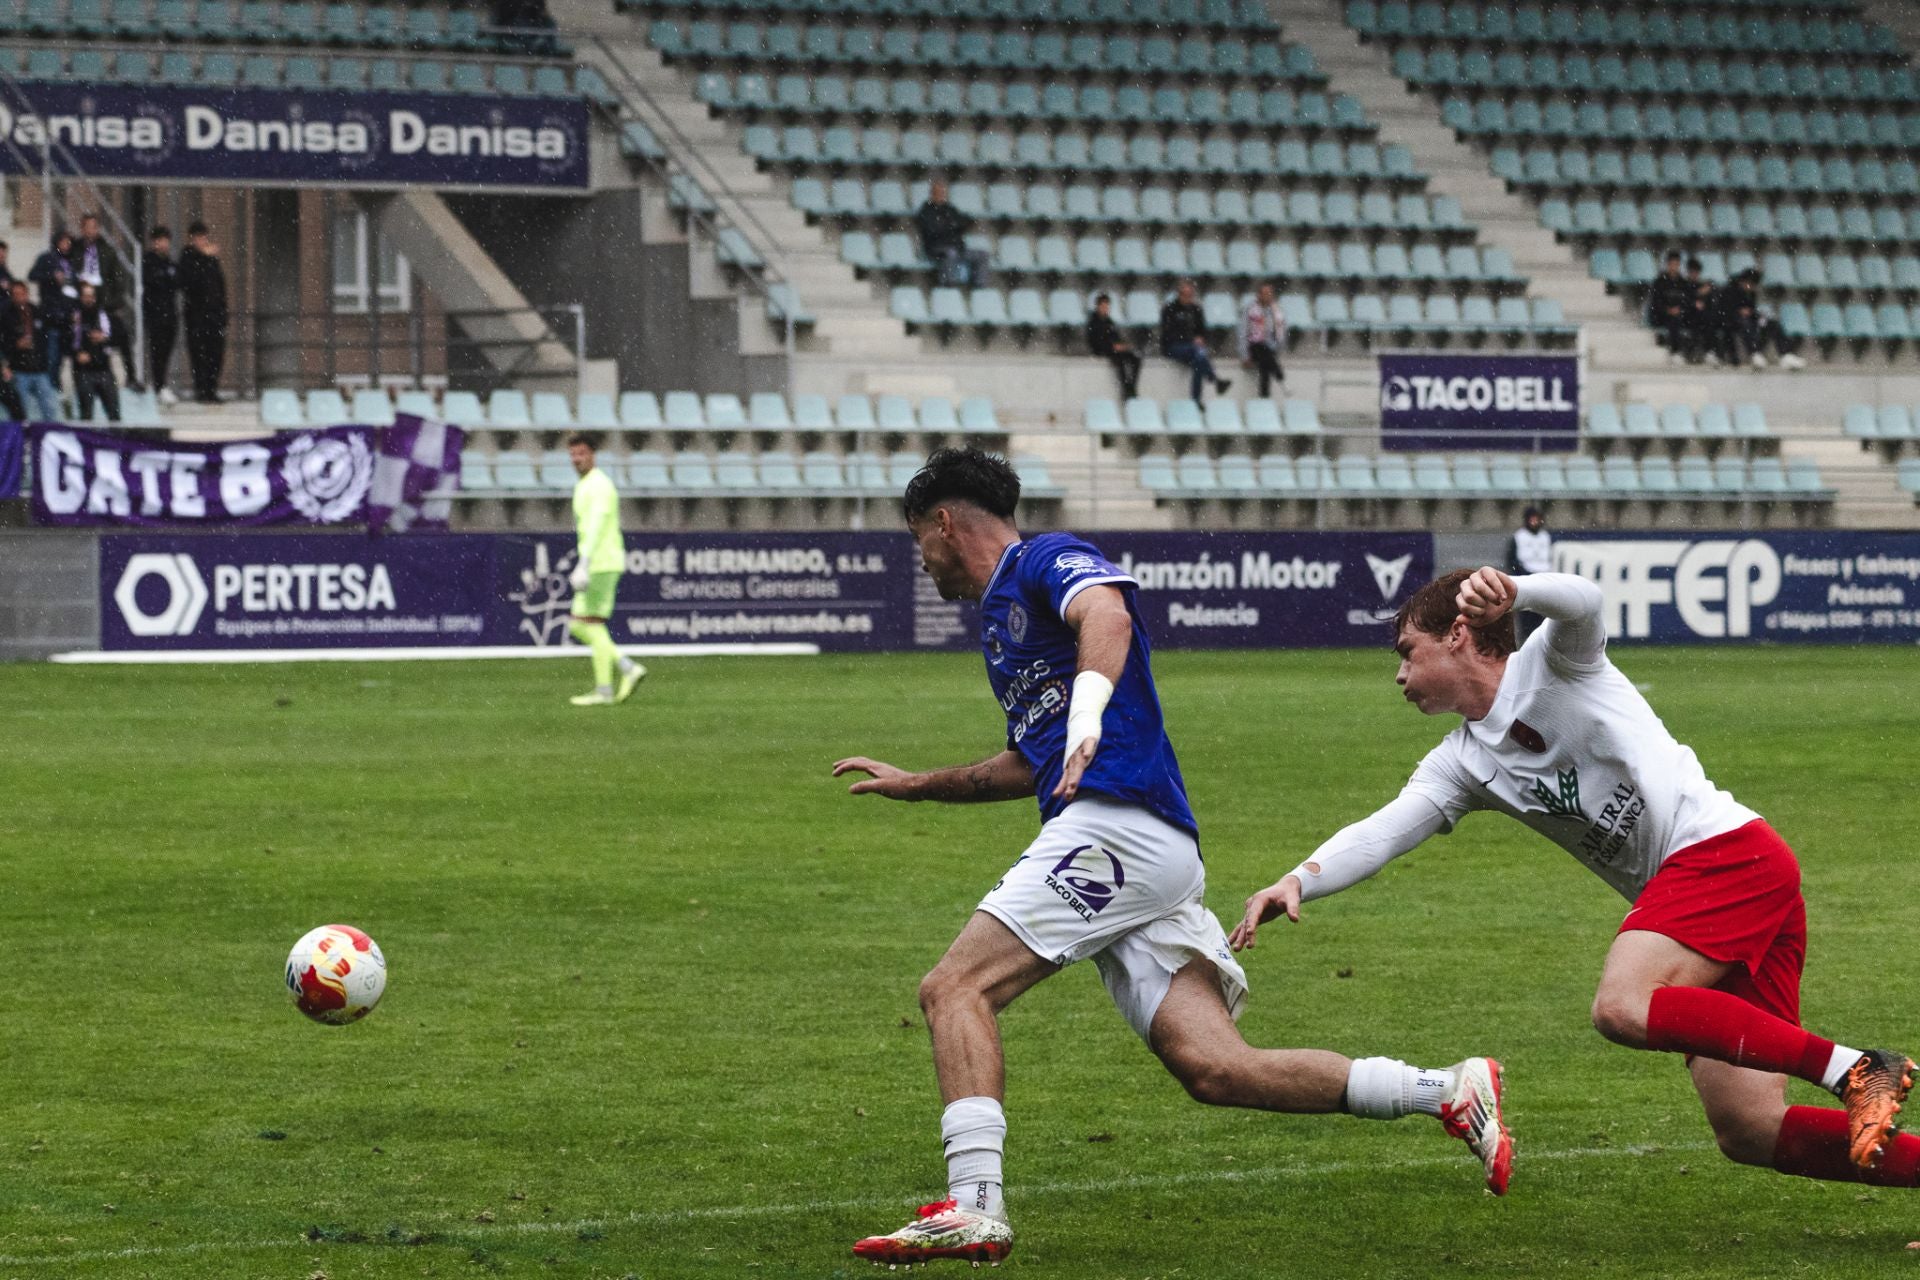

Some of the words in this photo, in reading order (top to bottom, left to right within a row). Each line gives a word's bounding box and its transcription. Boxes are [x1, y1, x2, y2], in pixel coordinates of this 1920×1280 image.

[0, 106, 162, 149] anisa
[184, 105, 368, 153] Danisa
[389, 110, 567, 160] Danisa
[1410, 375, 1494, 412] TACO
[1495, 375, 1574, 412] BELL
[40, 431, 206, 517] GATE
[624, 544, 679, 575] OSÉ
[684, 549, 832, 577] HERNANDO,
[1241, 552, 1342, 590] Motor
[214, 564, 395, 611] PERTESA
[660, 576, 743, 599] Servicios
[746, 575, 840, 599] Generales
[627, 610, 873, 640] www.josehernando.es
[1168, 603, 1259, 627] Palencia
[1014, 687, 1062, 743] anisa
[1044, 874, 1071, 900] TACO
[1068, 897, 1093, 924] BELL
